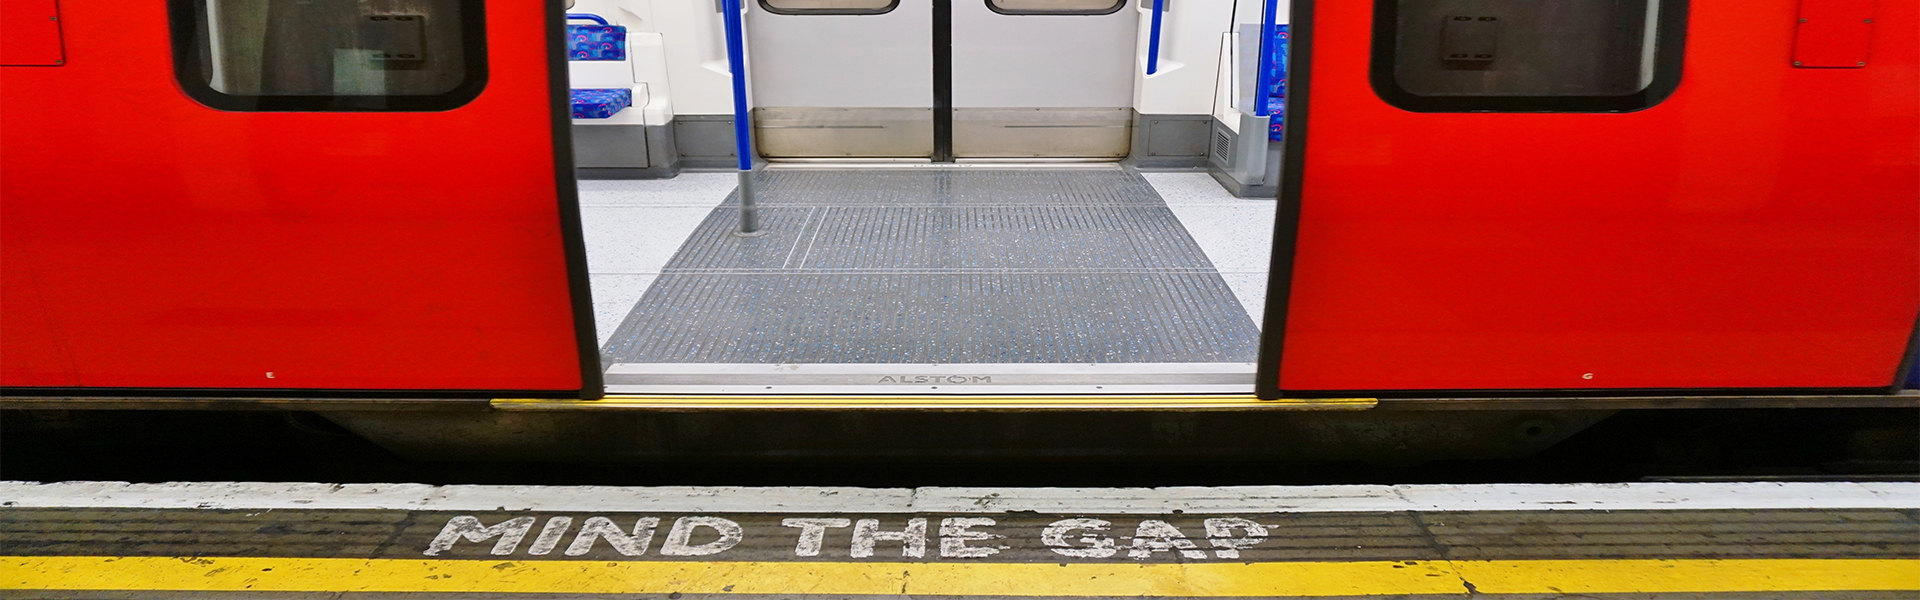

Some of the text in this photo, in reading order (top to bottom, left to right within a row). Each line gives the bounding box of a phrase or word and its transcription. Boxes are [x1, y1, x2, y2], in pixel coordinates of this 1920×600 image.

[878, 375, 992, 384] ALSTOM
[1582, 372, 1593, 380] G
[422, 515, 1274, 560] MIND THE GAP
